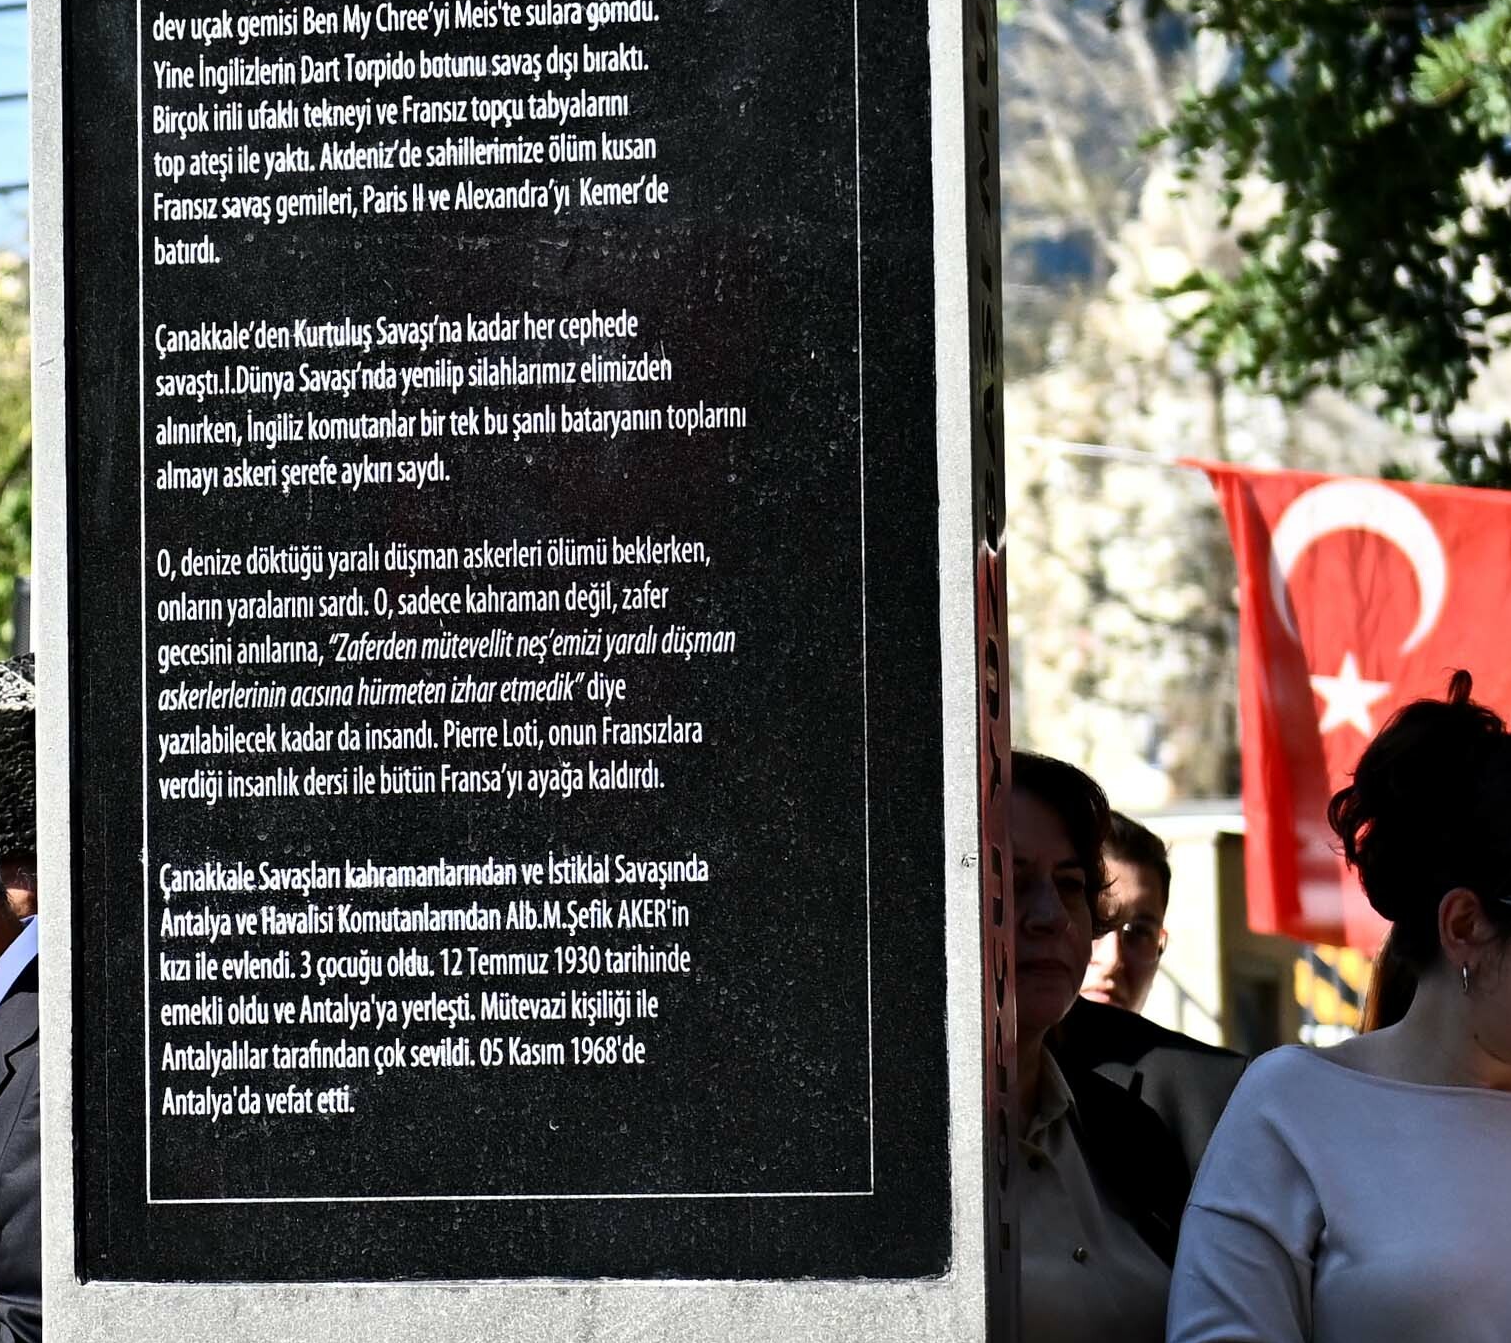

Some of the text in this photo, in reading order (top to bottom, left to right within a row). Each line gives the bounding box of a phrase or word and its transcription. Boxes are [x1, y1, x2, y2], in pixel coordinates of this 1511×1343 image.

[190, 8, 233, 46] uçak
[237, 7, 297, 44] gemisi
[153, 42, 648, 94] Yine İngilizlerin Dart Torpido savaş dışı bıraktı.
[153, 88, 628, 140] Birçok irili ufaklı tekneyi Fransız topçu tabyalarını
[189, 146, 232, 182] ateşi
[264, 142, 315, 180] yaktı.
[425, 135, 544, 166] sahillerimize
[548, 132, 596, 162] ölüm
[601, 131, 656, 160] kusan
[153, 192, 217, 220] Fransız
[221, 195, 271, 224] savaş
[275, 185, 357, 223] gemileri,
[363, 184, 407, 213] Paris
[154, 234, 220, 264] batırdı.
[292, 316, 372, 353] Kurtuluş
[467, 312, 520, 342] kadar
[559, 308, 637, 346] cephede
[398, 358, 463, 396] yenilip
[468, 356, 576, 386] silahlarımız
[580, 355, 671, 382] elimizden
[155, 400, 746, 450] alınırken, İngiliz komutanlar şanlı bataryanın toplarını
[156, 452, 449, 496] almayı askeri şerefe aykırı saydı.
[180, 534, 710, 580] denize döktüğü yaralı düşman askerleri ölümü beklerken,
[157, 579, 668, 627] onların yaralarını sardı. sadece kahraman değil, zafer
[157, 637, 231, 673] gecesini
[237, 634, 324, 667] anılarına,
[421, 628, 514, 659] mütevellit
[604, 623, 659, 657] yaralı
[661, 624, 735, 660] düşman
[157, 679, 286, 711] askerlerlerinin
[290, 684, 353, 707] acısına
[356, 676, 446, 705] hürmeten
[450, 673, 497, 703] izhar
[587, 672, 627, 708] diye
[158, 714, 702, 762] yazılabilecek kadar insandı. Pierre Loti, onun Fransızlara
[158, 768, 222, 805] verdiği
[227, 766, 299, 798] insanlık
[303, 766, 347, 795] dersi
[380, 764, 435, 793] bütün
[527, 761, 583, 798] ayağa
[588, 758, 664, 789] kaldırdı.
[159, 861, 256, 903] Çanakkale
[258, 859, 340, 897] Savaşları
[548, 850, 609, 884] İstiklal
[614, 852, 708, 890] Savaşında
[160, 905, 231, 943] Antalya
[261, 904, 335, 936] Havalisi
[336, 900, 501, 933] Komutanlarından
[617, 898, 689, 930] AKER'in
[159, 942, 690, 985] kızı evlendi. çocuğu oldu. Temmuz 1930 tarihinde
[160, 988, 631, 1030] emekli oldu Antalya'ya yerleşti. Mütevazi kişiliği
[161, 1034, 645, 1077] Antalyalılar tarafından sevildi. Kasım 1968'de
[162, 1084, 354, 1122] Antalya'da vefat etti.
